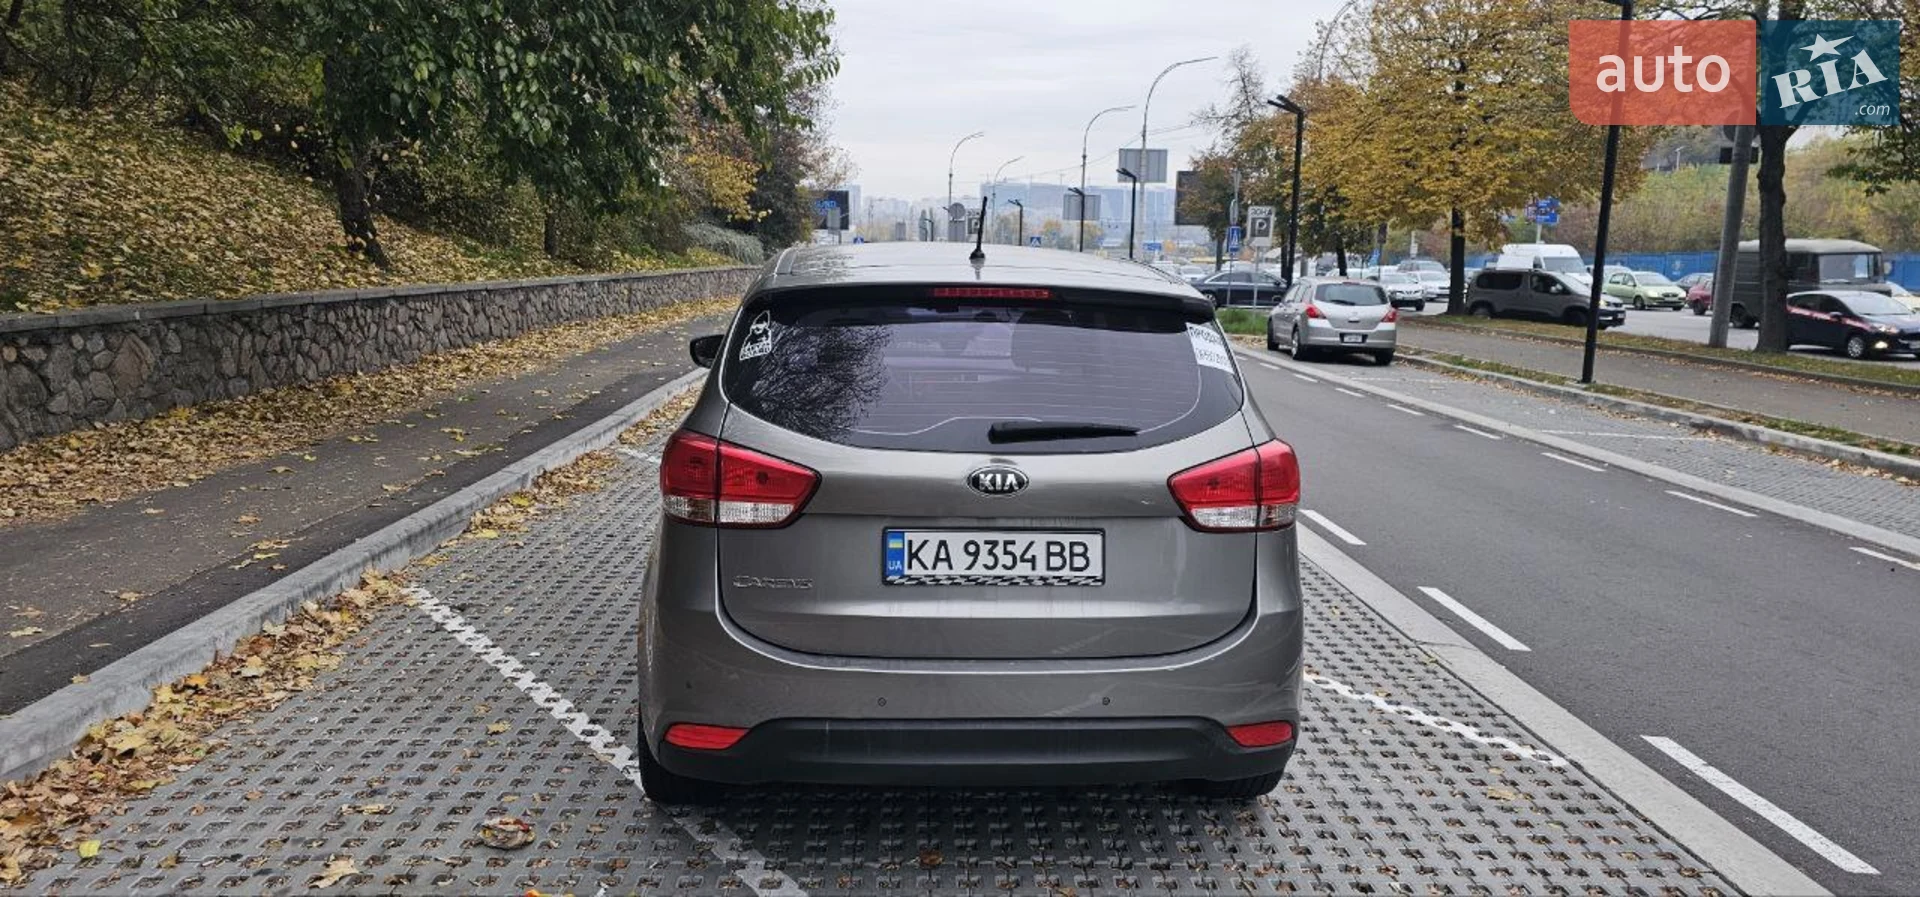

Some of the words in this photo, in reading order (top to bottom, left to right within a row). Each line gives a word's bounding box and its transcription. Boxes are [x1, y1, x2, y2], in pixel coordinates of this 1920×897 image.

[978, 473, 1020, 491] KIA
[907, 540, 953, 571] KA
[963, 540, 1037, 571] 9354
[1046, 541, 1090, 572] BB
[888, 560, 902, 571] UA
